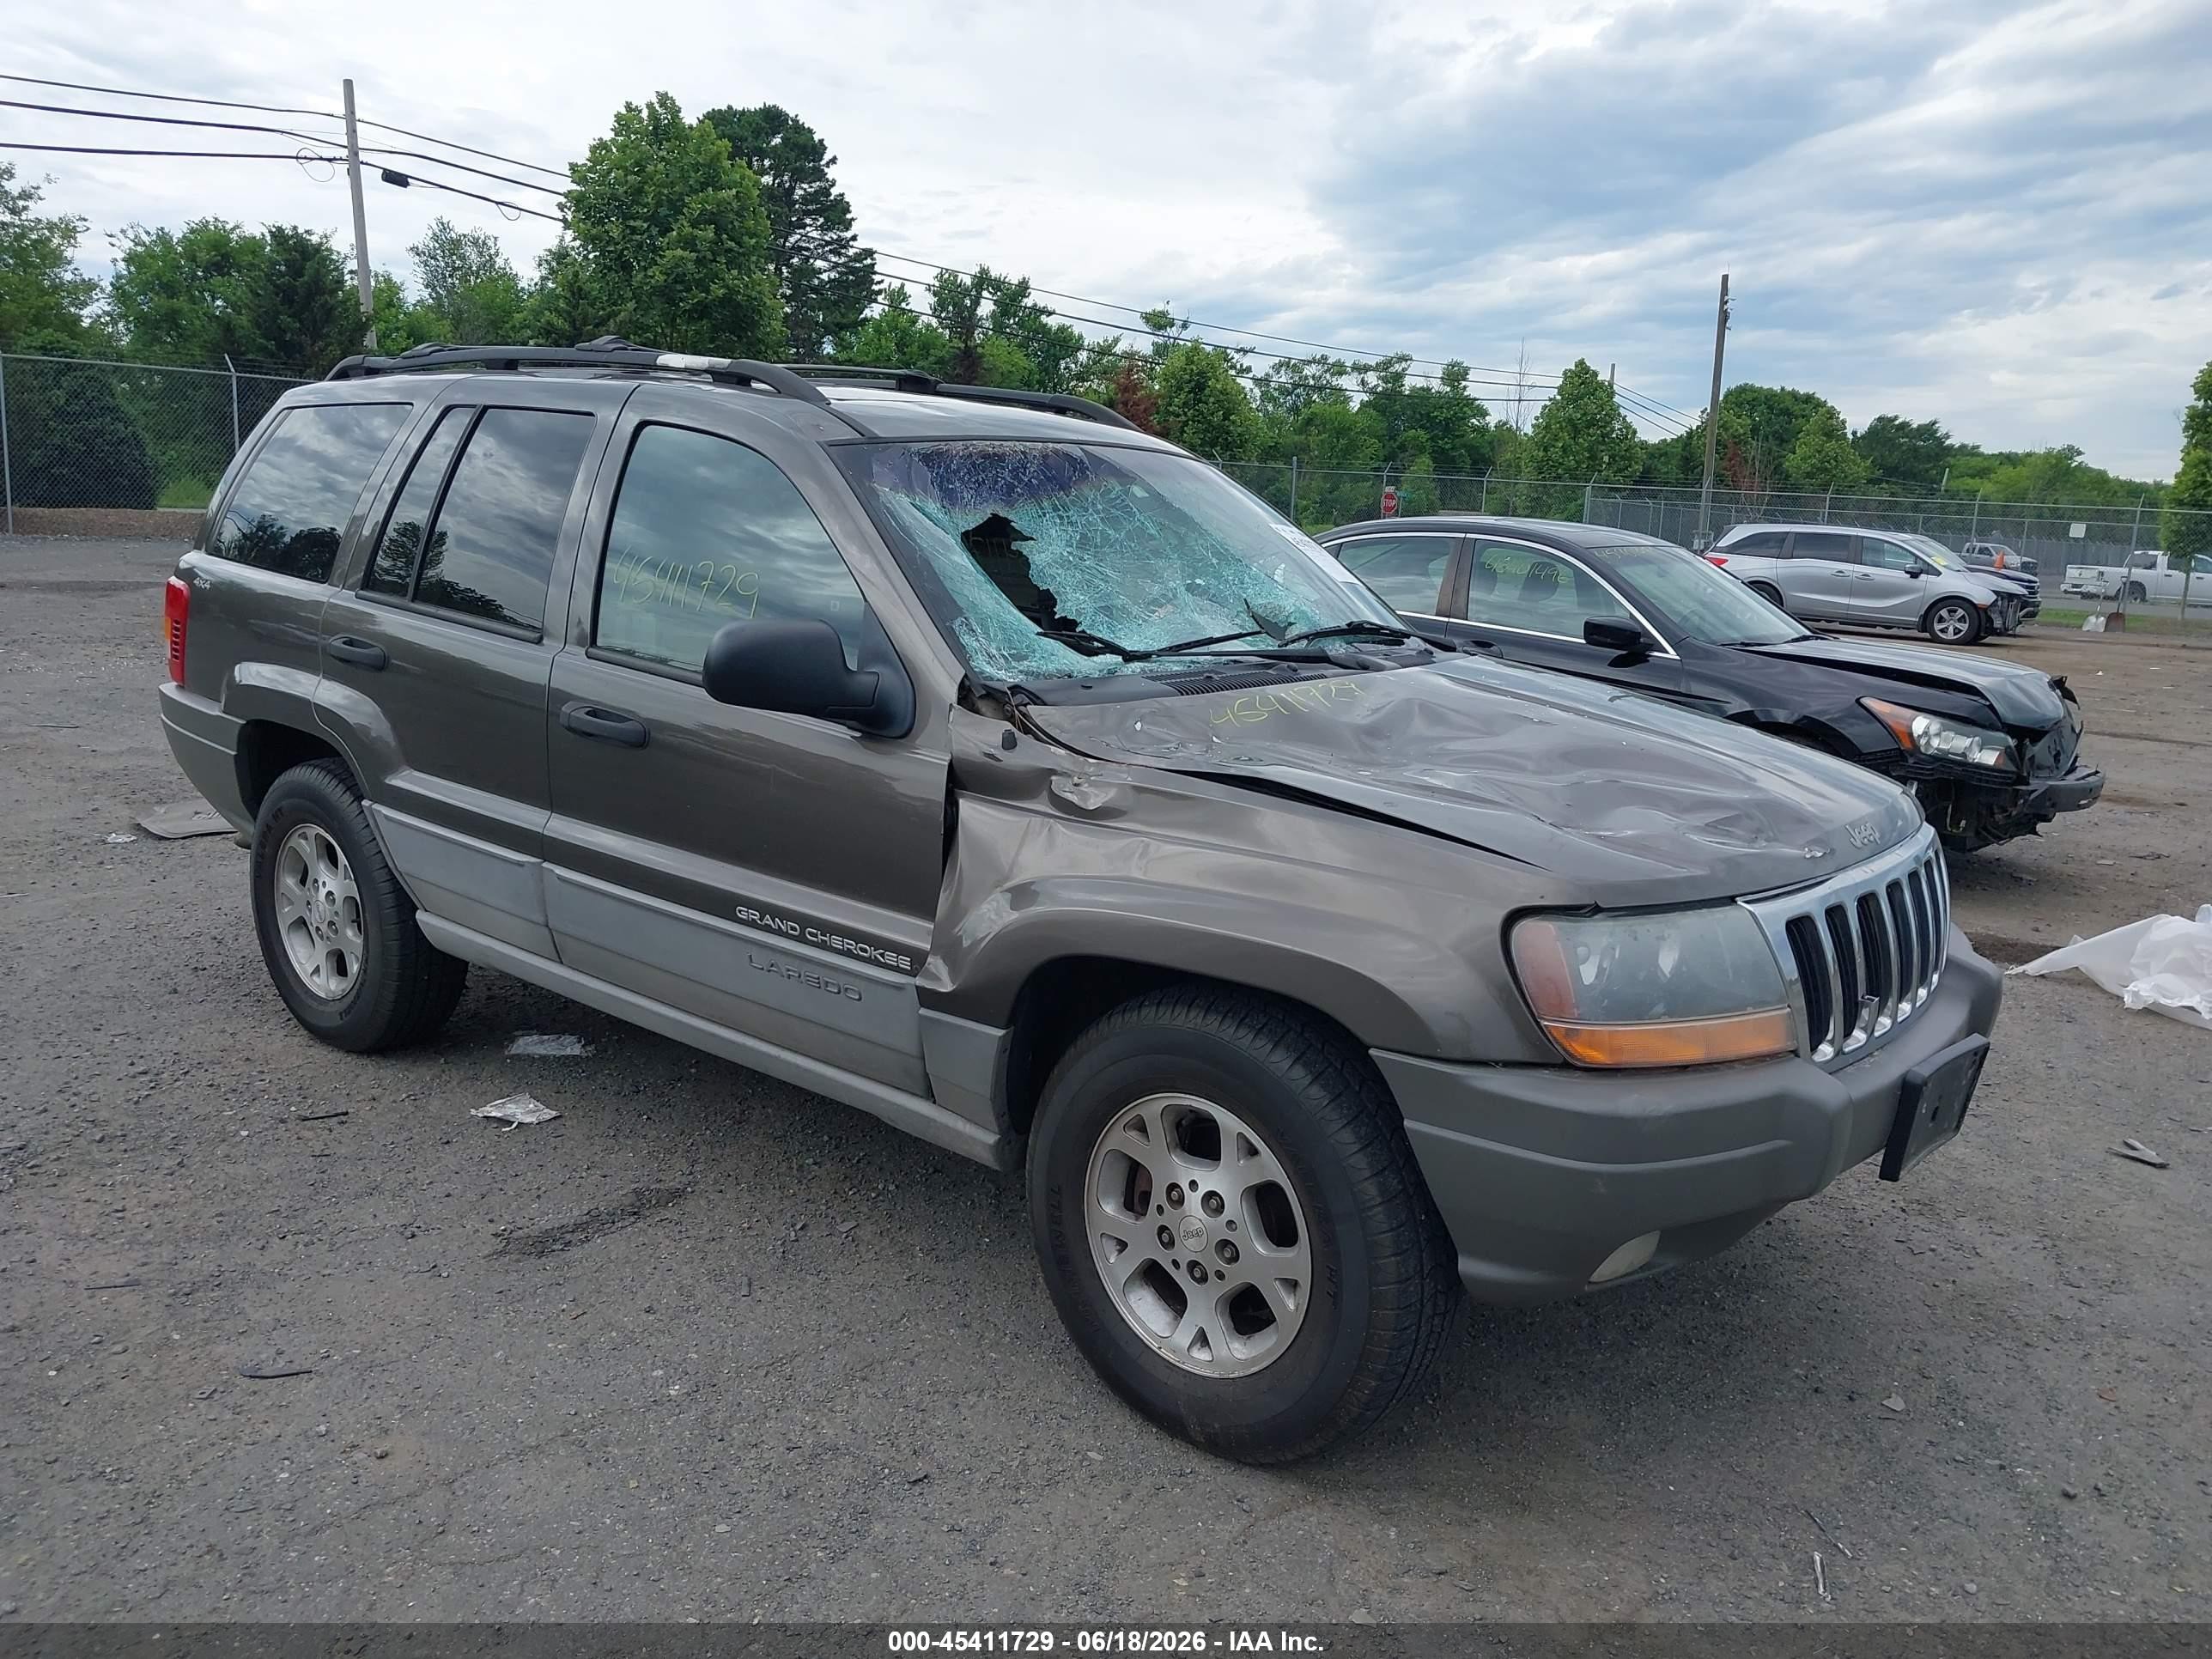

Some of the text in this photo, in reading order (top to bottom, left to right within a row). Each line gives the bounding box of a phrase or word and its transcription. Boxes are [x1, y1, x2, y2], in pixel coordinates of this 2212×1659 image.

[1383, 499, 1396, 507] STOP
[613, 545, 760, 619] 45411729
[1844, 822, 1881, 849] Jeep
[735, 906, 912, 970] GRAND CHEROKEE
[747, 952, 862, 1002] LAREDO
[1182, 1226, 1205, 1242] Jeep
